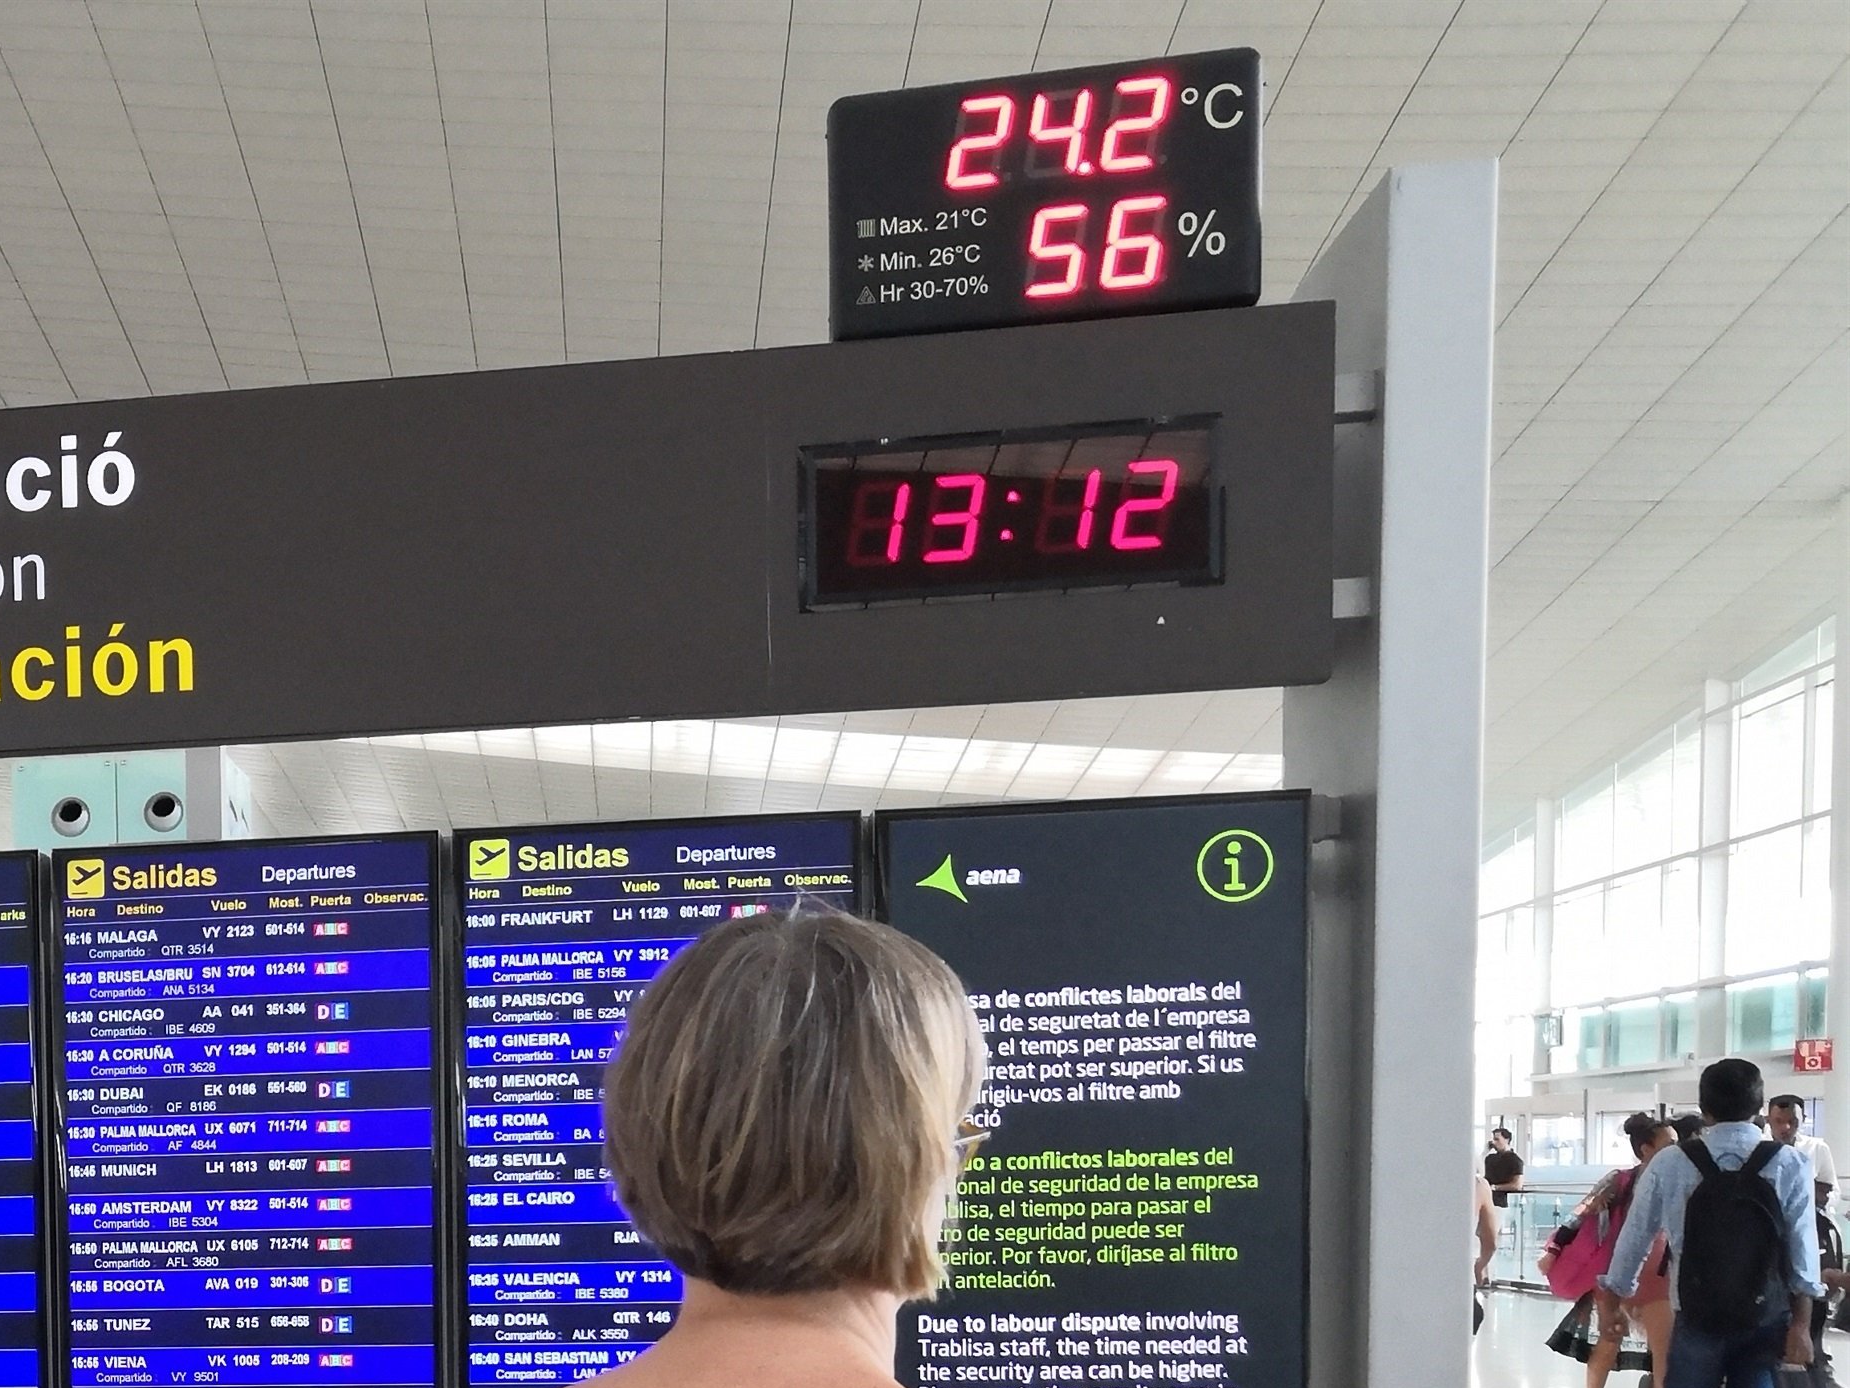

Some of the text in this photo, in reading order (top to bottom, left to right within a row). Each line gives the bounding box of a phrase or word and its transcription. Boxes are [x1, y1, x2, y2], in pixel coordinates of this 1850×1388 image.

[946, 76, 1244, 189] 24.2 °C
[880, 207, 987, 236] Max. 21°C
[880, 244, 981, 273] Min. 26°C
[1025, 196, 1226, 299] 56 %
[880, 275, 989, 303] Hr 30-70%
[887, 460, 1178, 562] 13:12
[518, 844, 776, 871] Salidas Departures
[112, 864, 356, 890] Salidas Departures
[623, 881, 660, 893] Vuelo
[965, 868, 1021, 886] aena
[117, 894, 352, 916] Destino Puerta
[502, 911, 593, 925] FRANKFURT
[98, 929, 158, 944] MALAGA
[502, 992, 584, 1007] PARIS/CDG
[995, 990, 1021, 1009] de
[1024, 987, 1123, 1007] conflictes
[1126, 982, 1207, 1004] laborals
[1211, 981, 1241, 1001] del
[98, 1008, 164, 1022] CHICAGO
[999, 1013, 1024, 1032] de
[1028, 1011, 1122, 1034] seguretat
[1125, 1009, 1149, 1028] de
[998, 1037, 1015, 1056] el
[1019, 1038, 1079, 1058] temps
[1084, 1037, 1115, 1057] per
[1119, 1035, 1181, 1056] passar
[1186, 1031, 1203, 1050] el
[1208, 1029, 1257, 1048] filtre
[502, 1073, 579, 1087] MENORCA
[984, 1054, 1244, 1082] retat pot ser superior. Si us
[100, 1087, 144, 1101] DUBAI
[977, 1079, 1181, 1107] irigiu-vos al filtre amb
[989, 1156, 1001, 1171] a
[1006, 1151, 1103, 1170] conflictos
[1107, 1148, 1199, 1168] laborales
[1204, 1146, 1233, 1165] del
[1001, 1176, 1024, 1194] de
[1028, 1173, 1121, 1197] seguridad
[1126, 1172, 1149, 1191] de
[1155, 1172, 1171, 1190] la
[1176, 1174, 1259, 1193] empresa
[947, 1195, 1211, 1220] blisa, el tiempo para pasar el
[967, 1224, 990, 1242] de
[995, 1222, 1086, 1245] seguridad
[1091, 1220, 1150, 1243] puede
[1155, 1223, 1185, 1238] ser
[938, 1242, 1238, 1267] perior. Por favor, diríjase al filtro
[103, 1279, 165, 1292] BOGOTA
[504, 1273, 580, 1285] VALENCIA
[955, 1270, 1056, 1289] antelación.
[504, 1314, 548, 1325] DOHA
[918, 1310, 1239, 1335] Due to labour dispute involving
[918, 1335, 1248, 1357] Trablisa staff, the time needed at
[104, 1356, 147, 1369] VIENA
[917, 1359, 1229, 1384] the security area can be higher.
